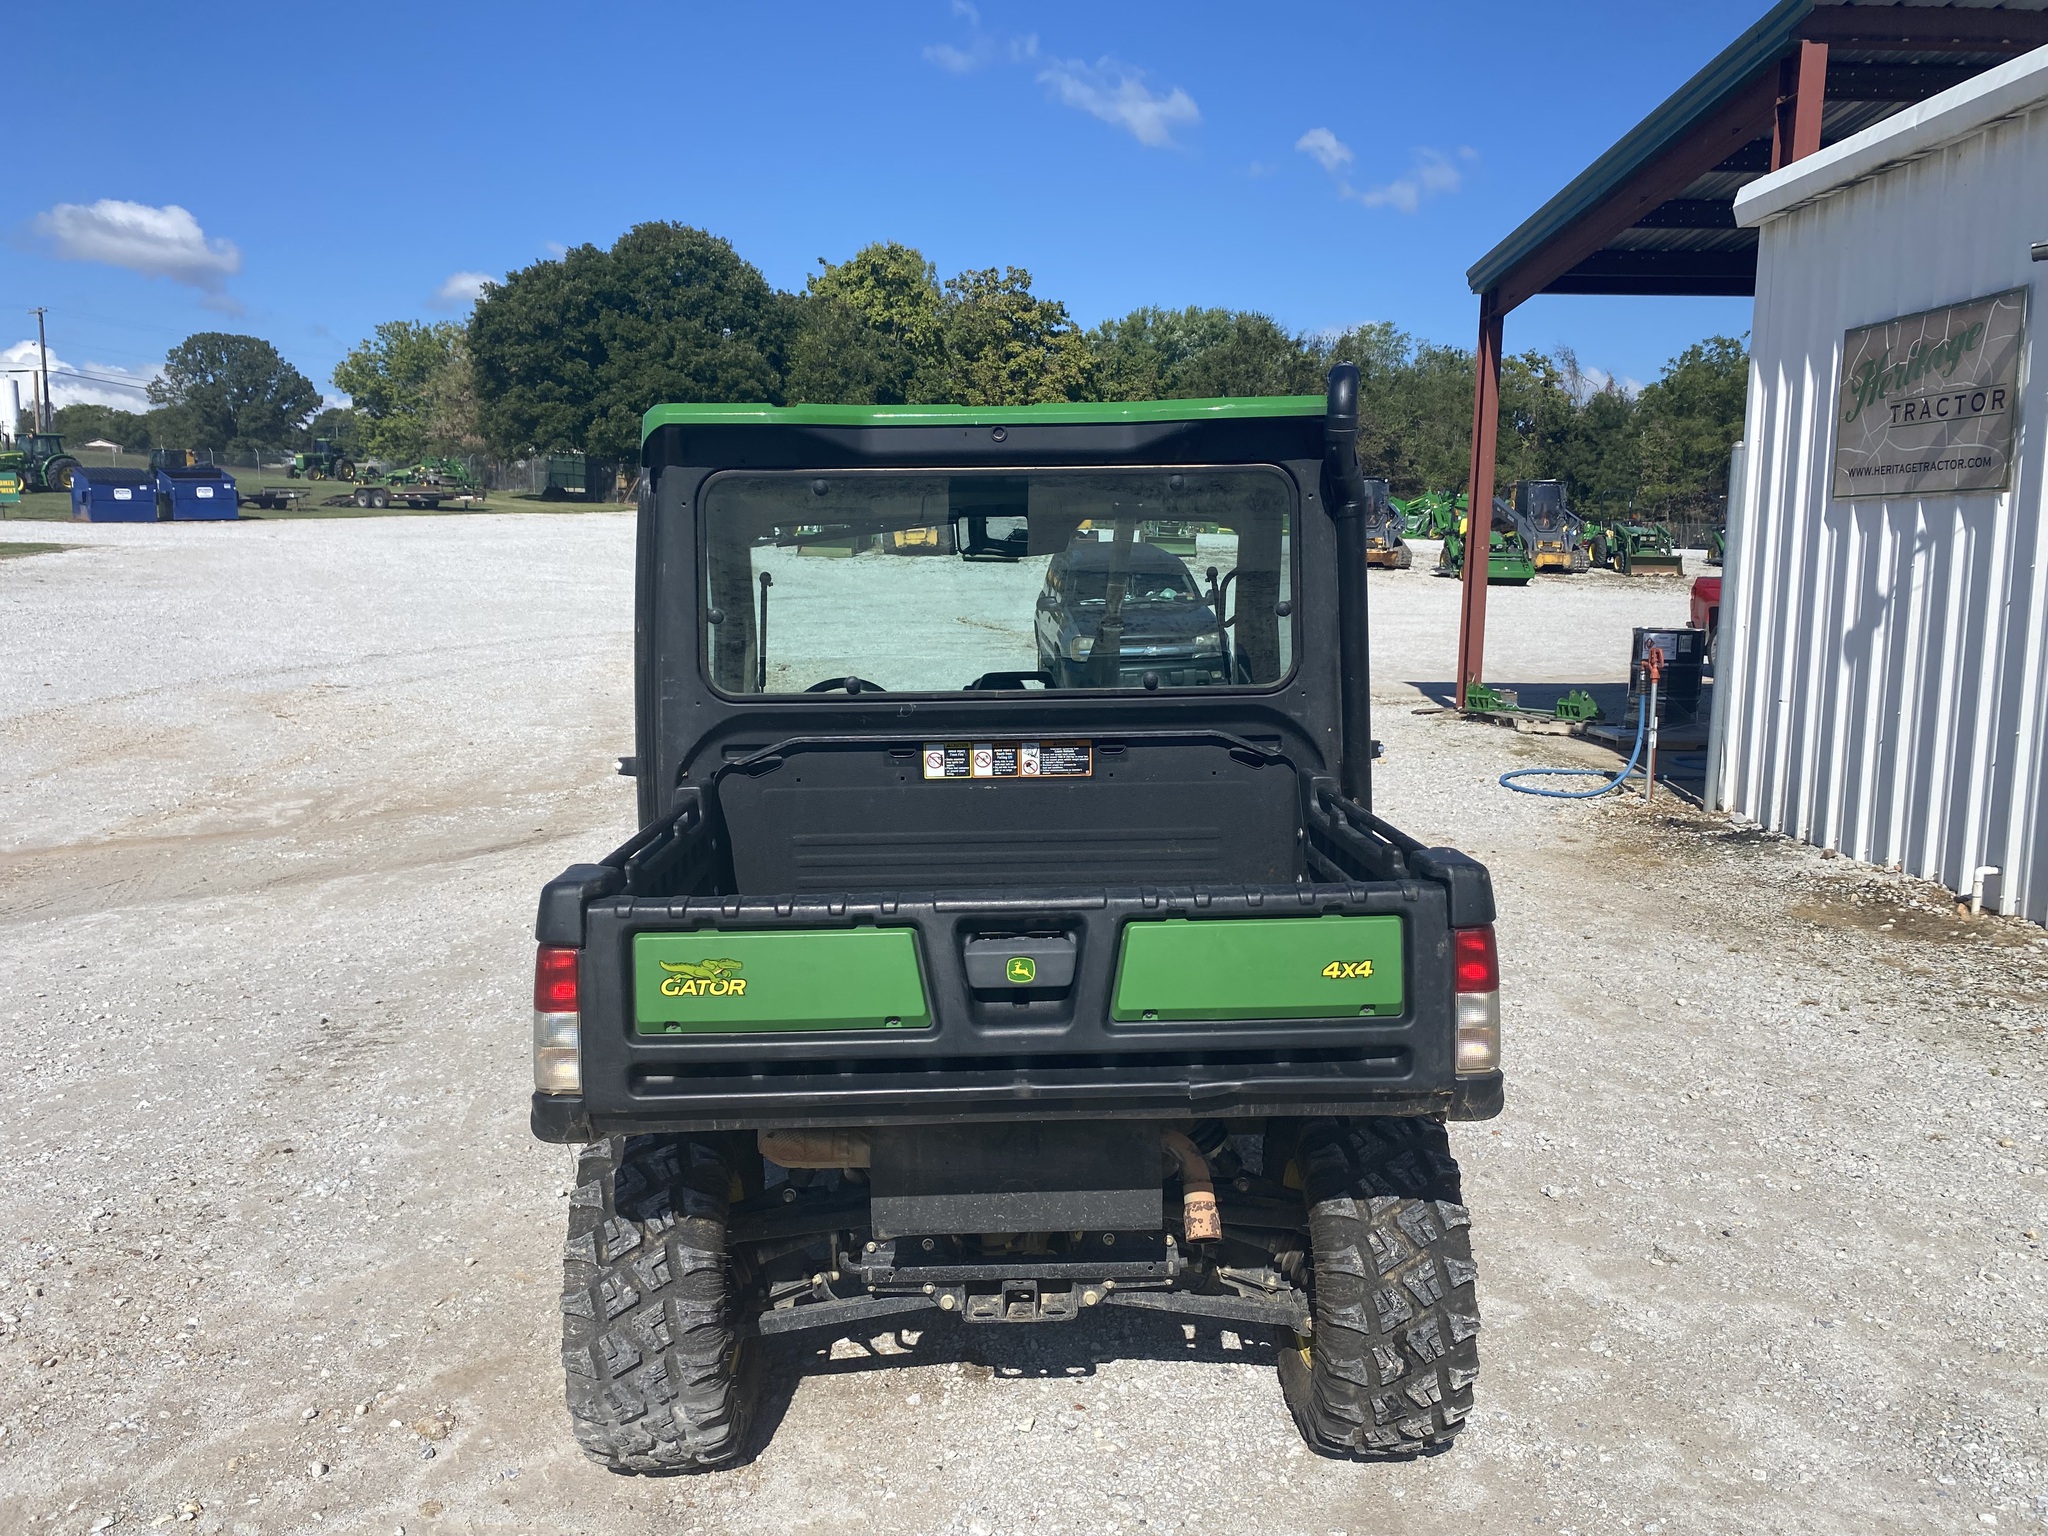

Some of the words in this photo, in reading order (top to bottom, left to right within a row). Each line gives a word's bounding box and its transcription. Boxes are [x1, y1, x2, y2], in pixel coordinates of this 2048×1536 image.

[1845, 321, 1985, 423] Heritage
[1890, 388, 2007, 424] TRACTOR
[1847, 456, 1992, 478] WWW.HERITAGETRACTOR.COM
[660, 978, 747, 997] GATOR
